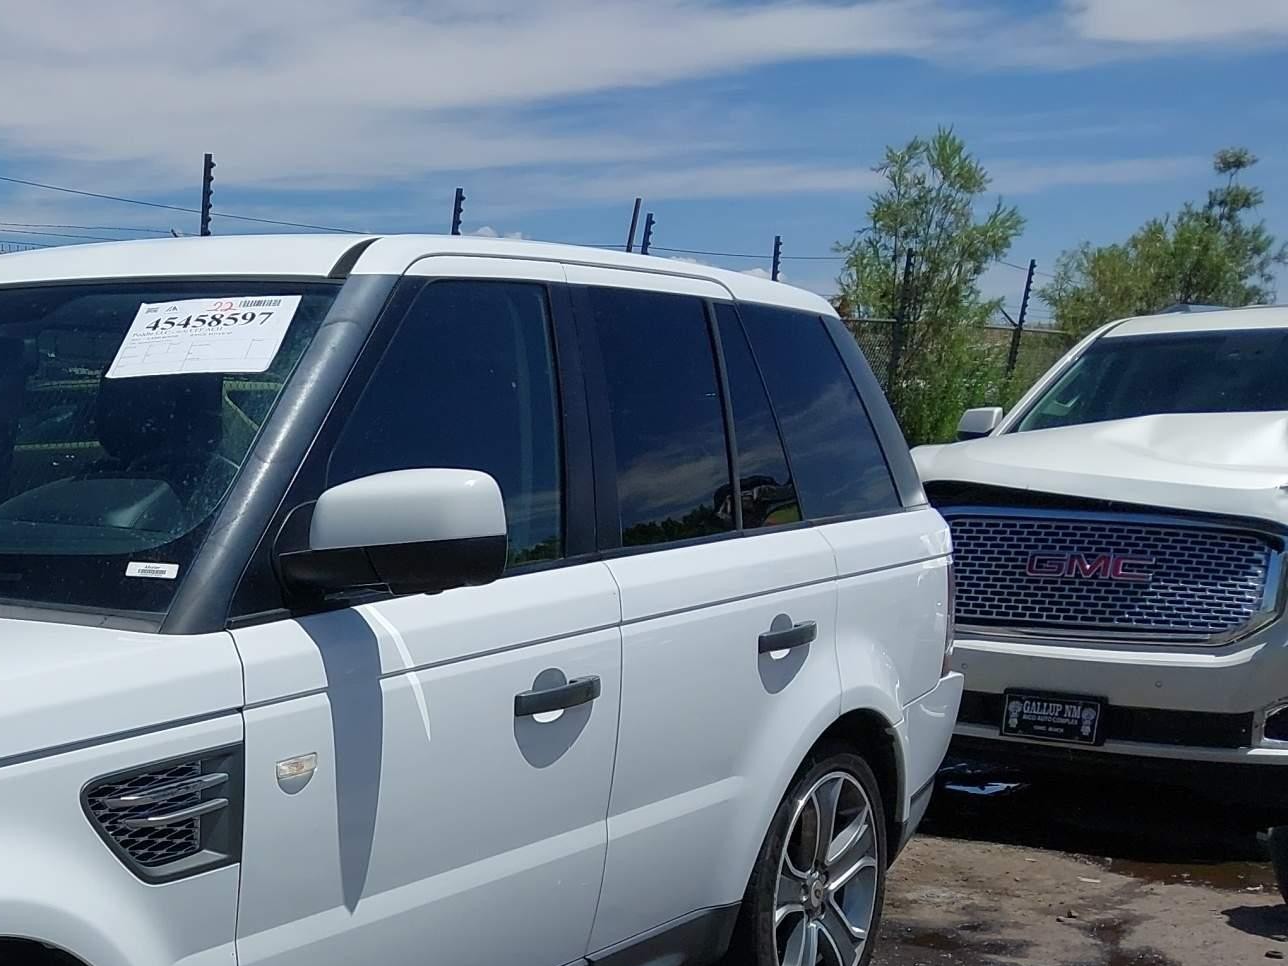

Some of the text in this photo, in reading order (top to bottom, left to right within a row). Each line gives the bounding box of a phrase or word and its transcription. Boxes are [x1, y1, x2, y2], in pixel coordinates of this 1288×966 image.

[145, 312, 275, 332] 45458597
[1026, 552, 1156, 582] GMC
[1022, 700, 1082, 719] GALLUP NM
